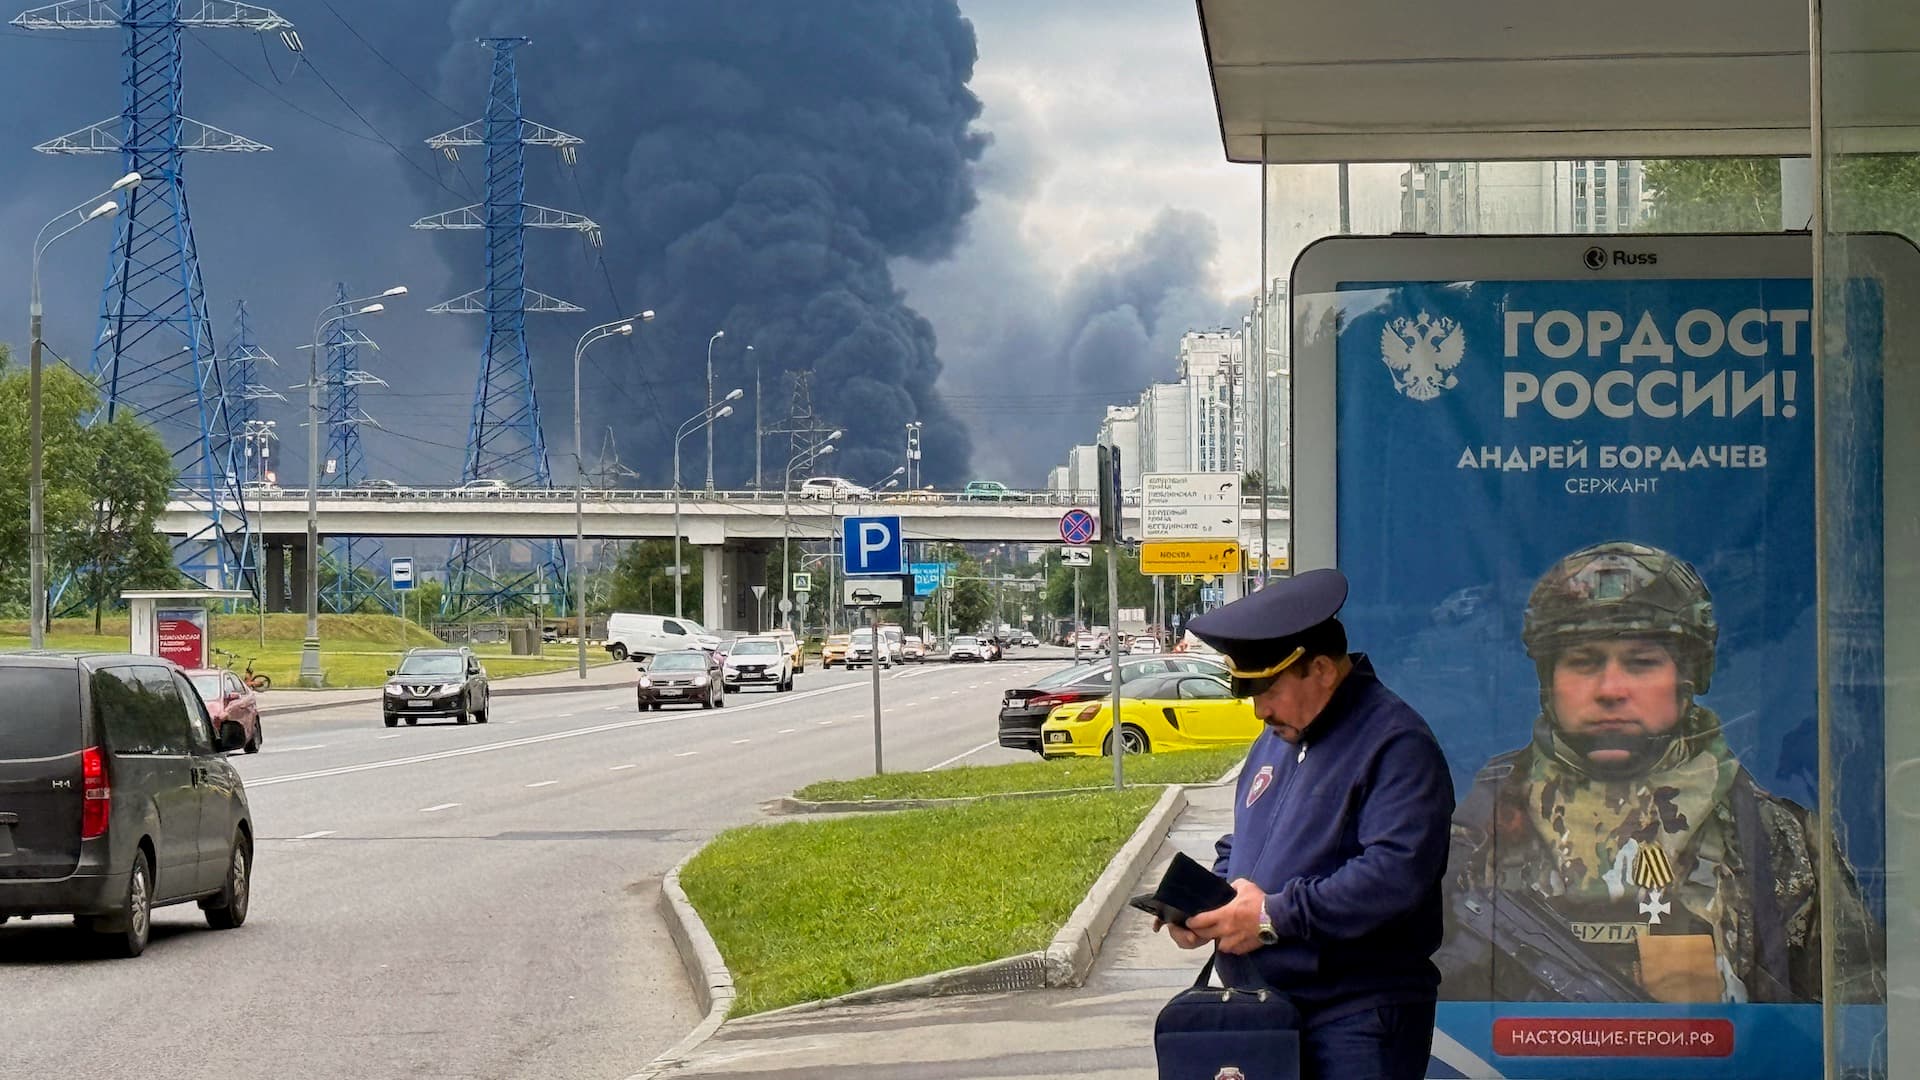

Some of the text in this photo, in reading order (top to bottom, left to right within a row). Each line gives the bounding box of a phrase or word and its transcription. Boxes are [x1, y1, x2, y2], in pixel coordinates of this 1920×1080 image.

[1613, 250, 1657, 265] Russ
[1504, 309, 1817, 363] ГОРДОСТ
[1503, 369, 1797, 419] РОССИИ!
[1457, 440, 1767, 471] АНДРЕЙ БОРДАЧЕВ
[1564, 478, 1658, 494] СЕРЖАНТ
[860, 523, 891, 567] P
